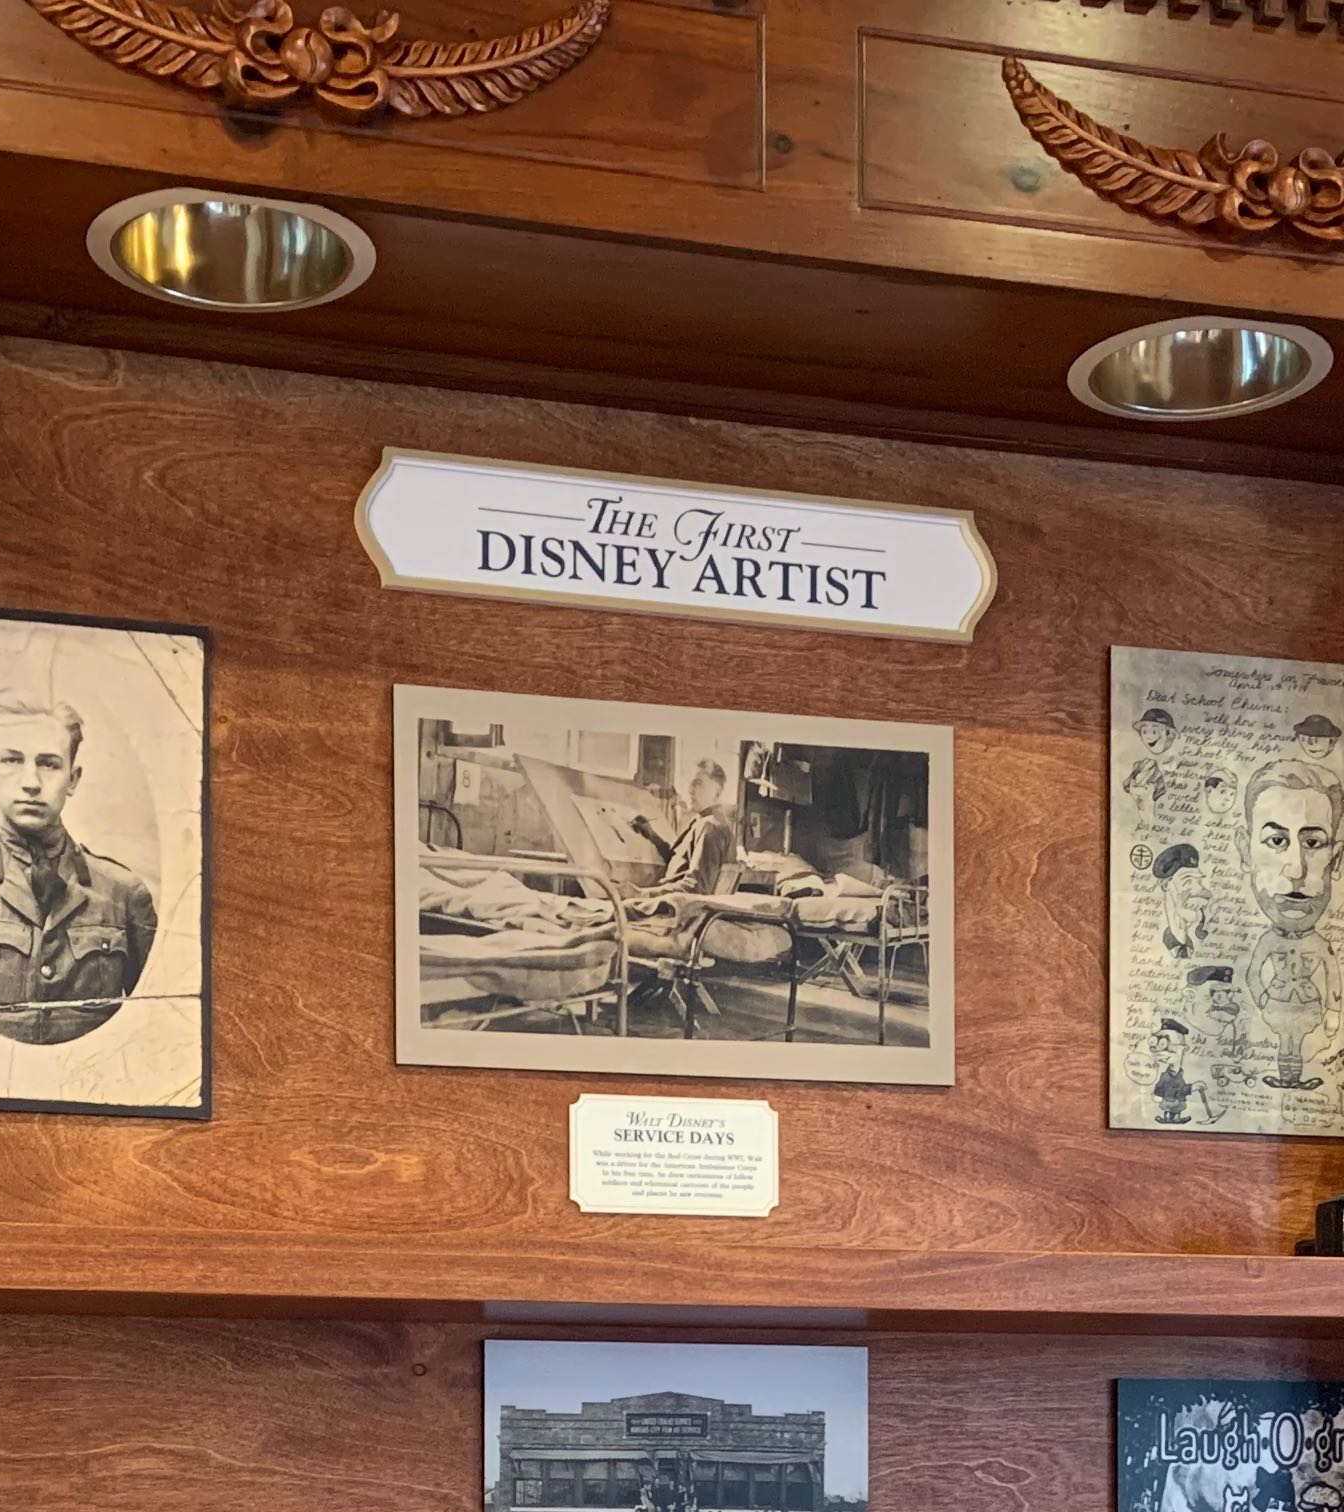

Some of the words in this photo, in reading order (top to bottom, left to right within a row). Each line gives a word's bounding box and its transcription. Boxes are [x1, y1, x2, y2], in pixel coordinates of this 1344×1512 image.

[585, 495, 658, 541] THE
[673, 507, 802, 562] FIRST
[475, 528, 678, 590] DISNEY
[693, 552, 888, 611] ARTIST
[613, 1128, 685, 1145] SERVICE
[689, 1131, 735, 1146] DAYS
